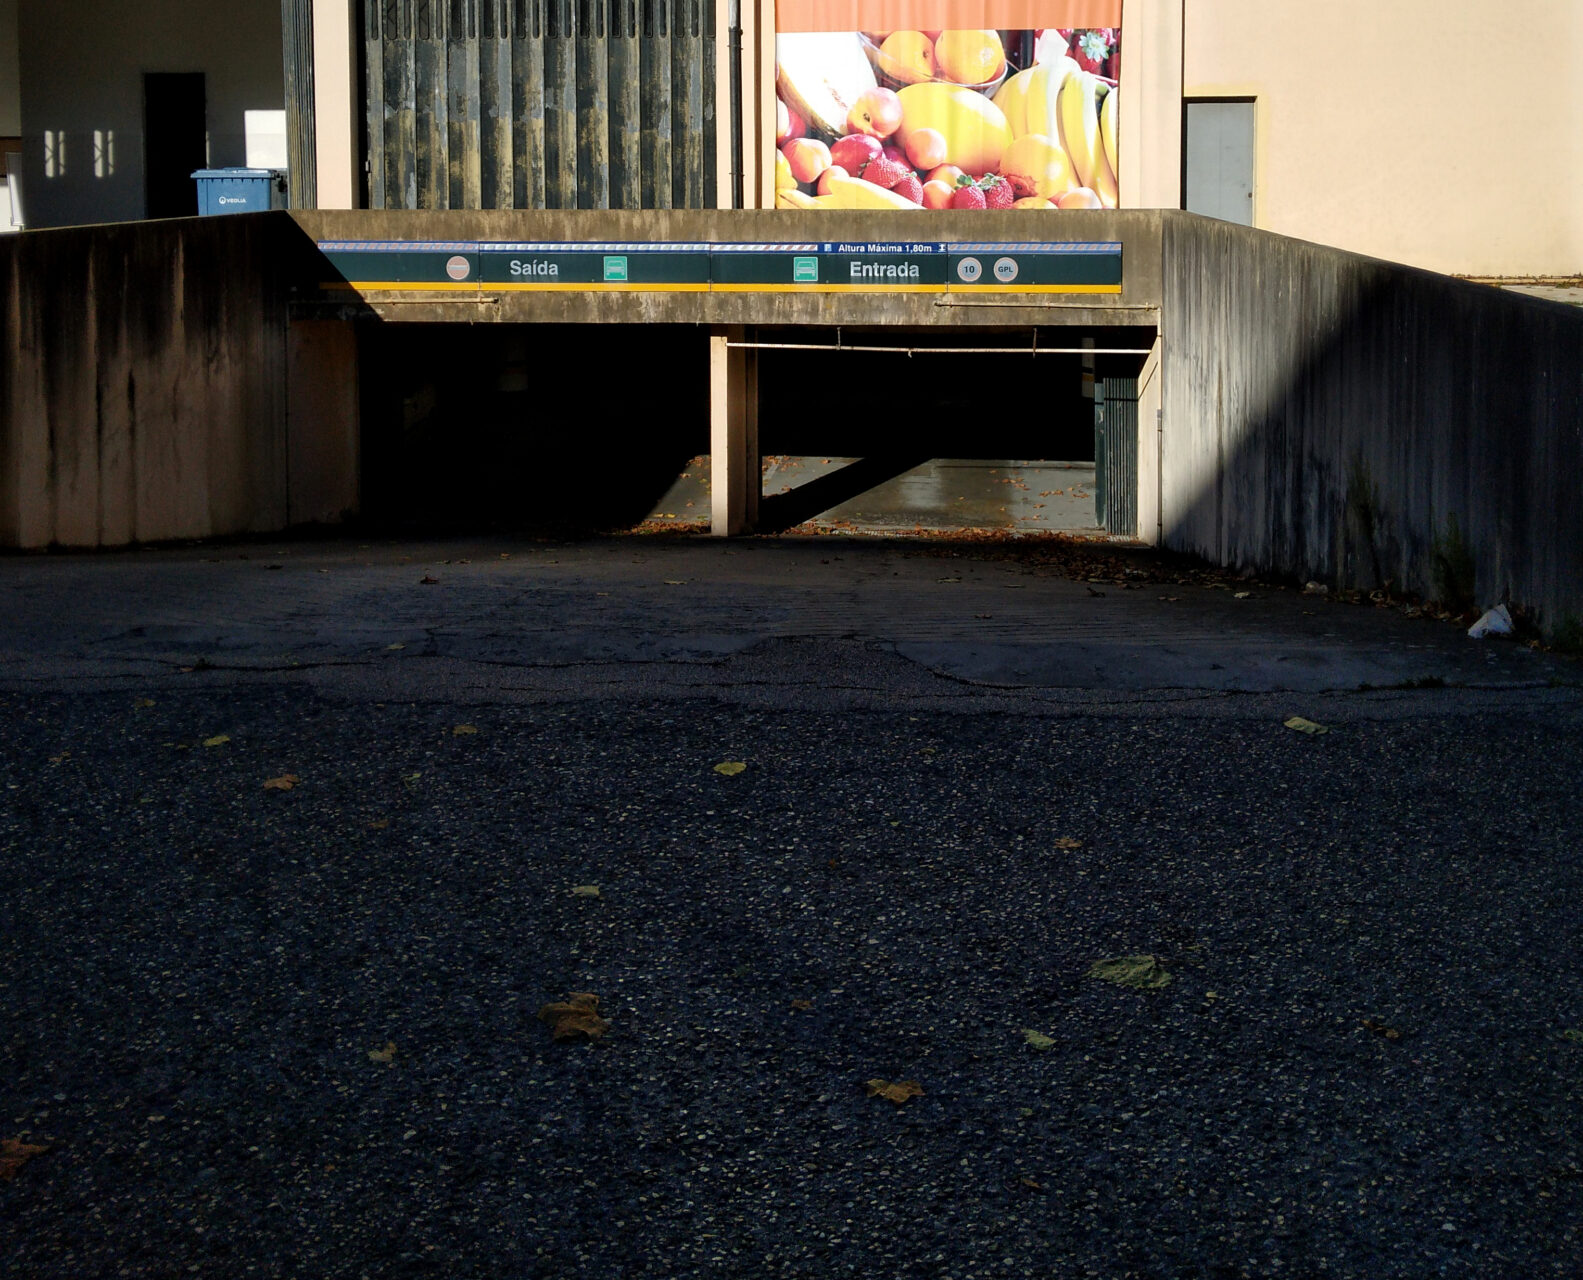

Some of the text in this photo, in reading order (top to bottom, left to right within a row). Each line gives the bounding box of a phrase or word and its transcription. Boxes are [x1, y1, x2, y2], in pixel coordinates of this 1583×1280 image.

[838, 244, 865, 253] Altura
[867, 243, 903, 253] Máxima
[905, 244, 932, 254] 1,80m
[509, 259, 559, 276] Saída
[850, 261, 920, 277] Entrada
[964, 266, 975, 274] 10
